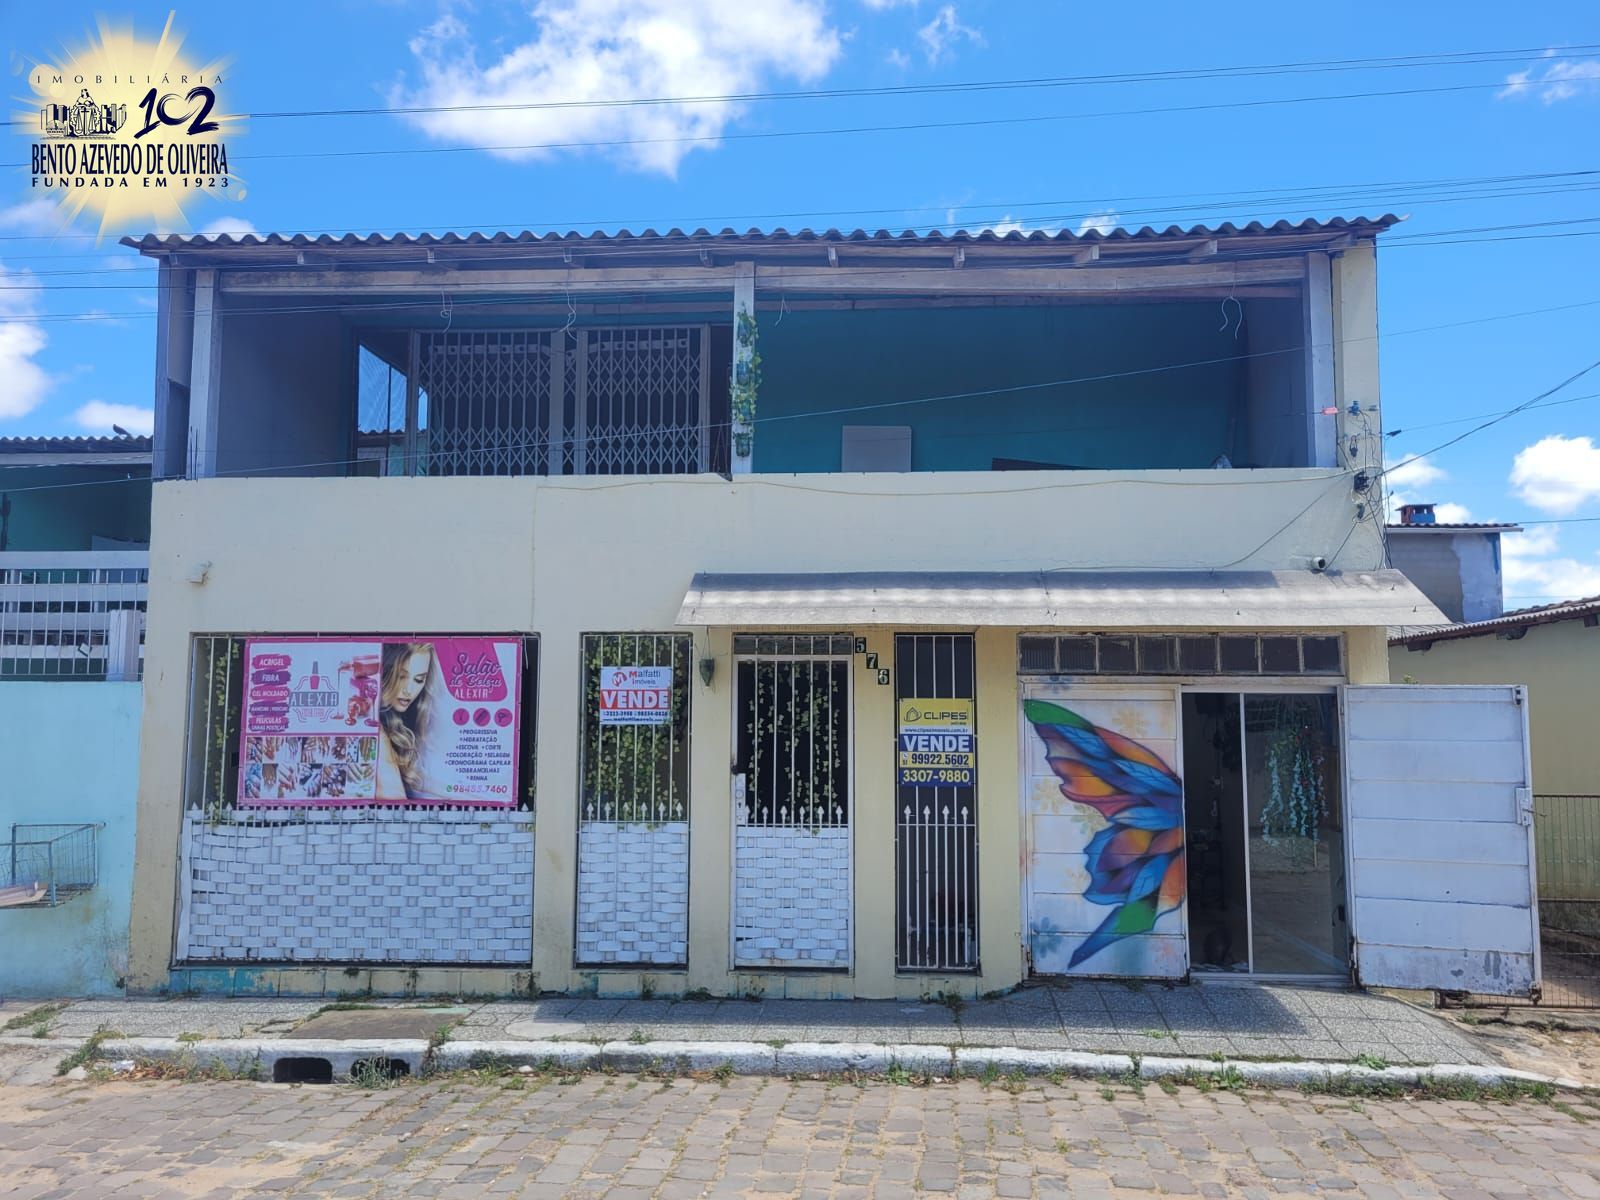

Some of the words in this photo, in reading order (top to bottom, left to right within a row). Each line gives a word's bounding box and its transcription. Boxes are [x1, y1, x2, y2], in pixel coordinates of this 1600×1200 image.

[259, 658, 284, 666] ACRIGEL
[451, 652, 502, 677] Salão
[262, 674, 280, 682] FIBRA
[629, 669, 660, 678] Malfatti
[602, 690, 669, 709] VENDE
[924, 712, 967, 720] CLIPES
[903, 735, 970, 752] VENDE
[911, 753, 969, 766] 99922.5602
[903, 769, 970, 783] 3307-9880
